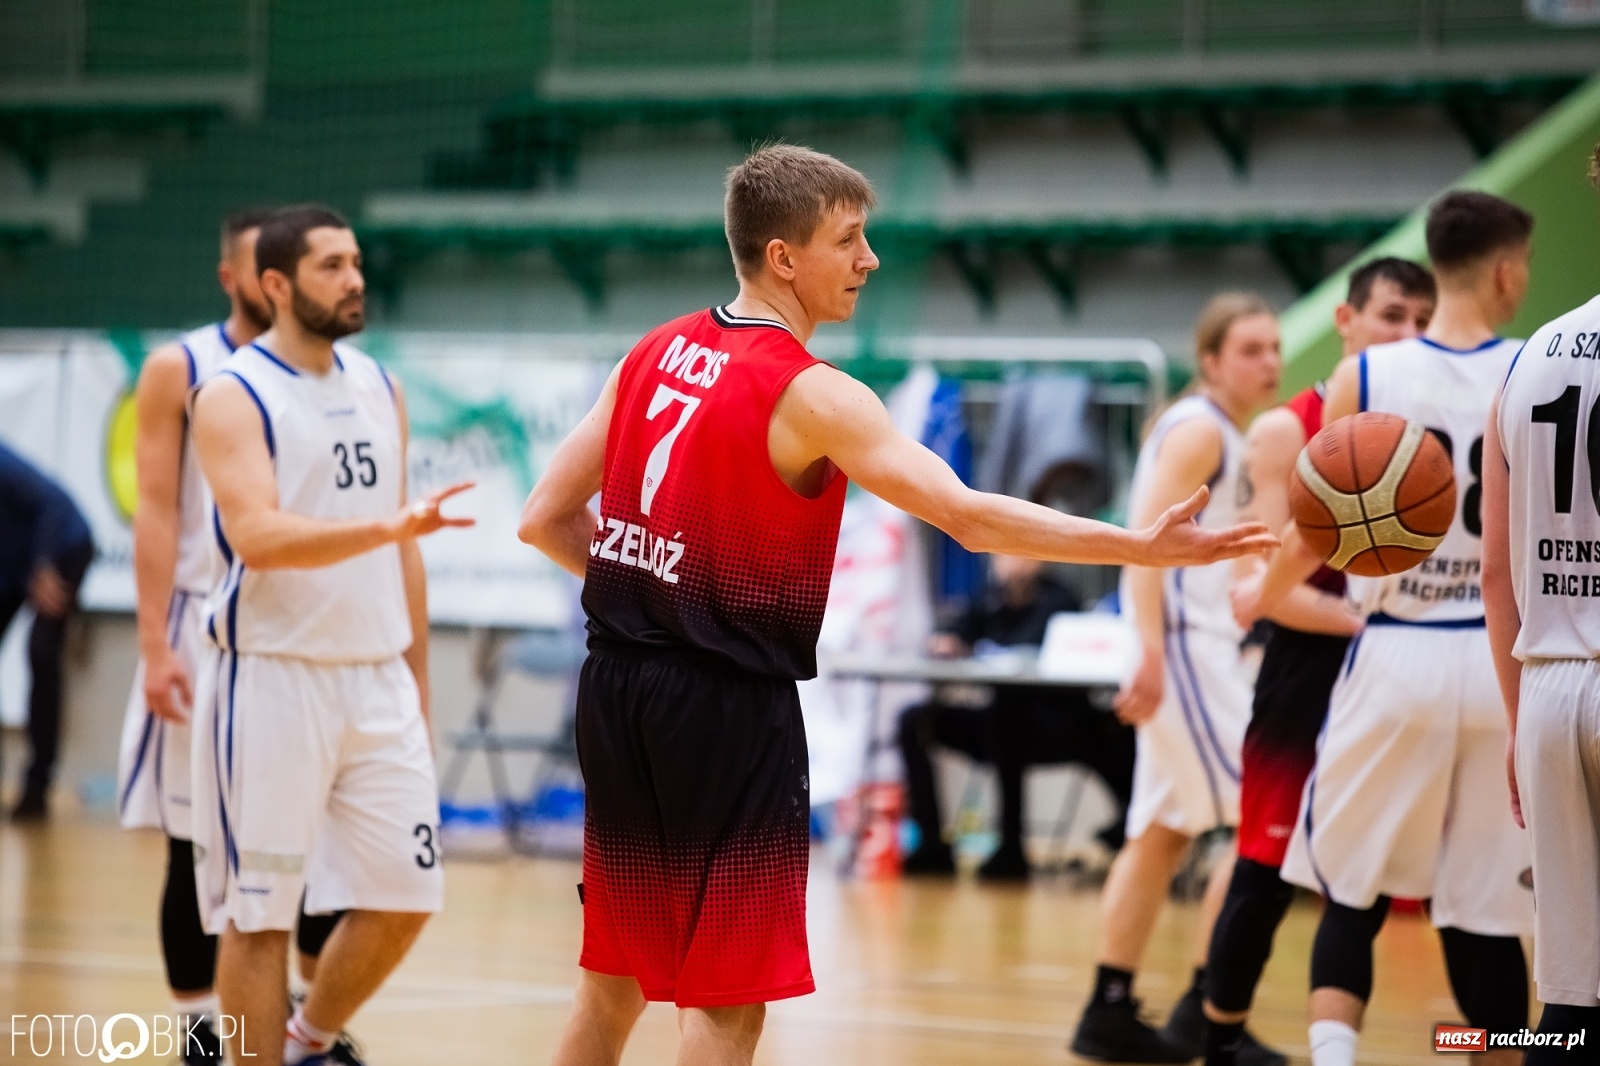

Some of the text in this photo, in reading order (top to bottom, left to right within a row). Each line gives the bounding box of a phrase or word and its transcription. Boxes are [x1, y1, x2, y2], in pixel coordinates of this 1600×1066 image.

[1546, 333, 1562, 357] O.
[333, 442, 377, 488] 35
[640, 383, 701, 516] 7
[413, 823, 440, 870] 3
